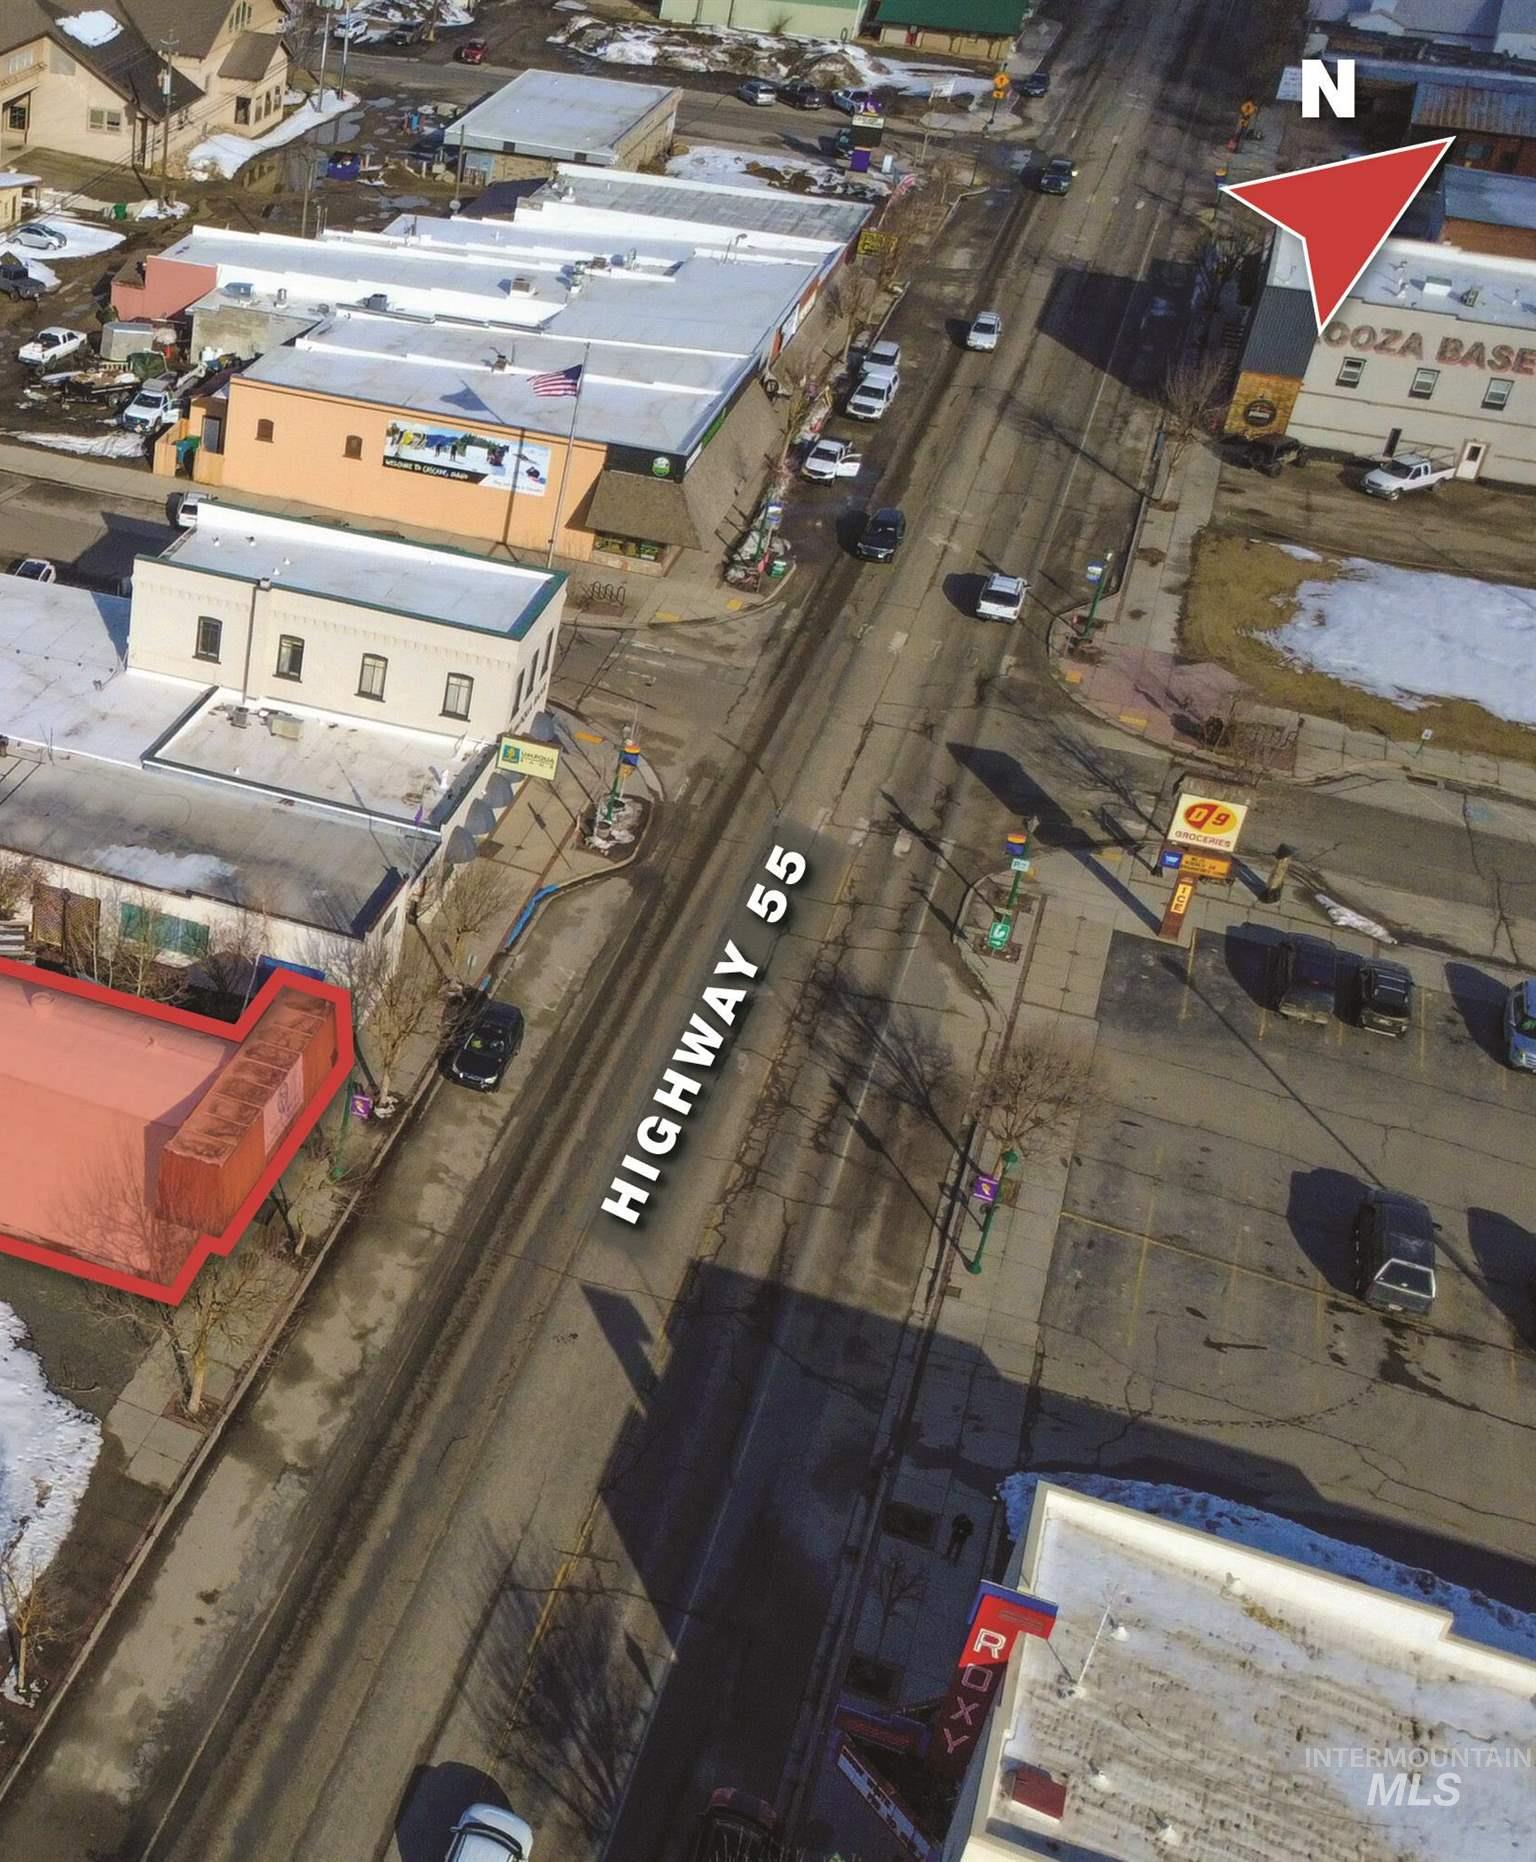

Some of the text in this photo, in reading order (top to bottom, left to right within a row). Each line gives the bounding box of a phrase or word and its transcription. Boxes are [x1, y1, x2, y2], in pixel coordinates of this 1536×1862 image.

[1314, 320, 1424, 361] OOZA
[1175, 830, 1231, 848] GROCERIES
[1173, 886, 1187, 912] ICE
[943, 1628, 1006, 1754] ROXY
